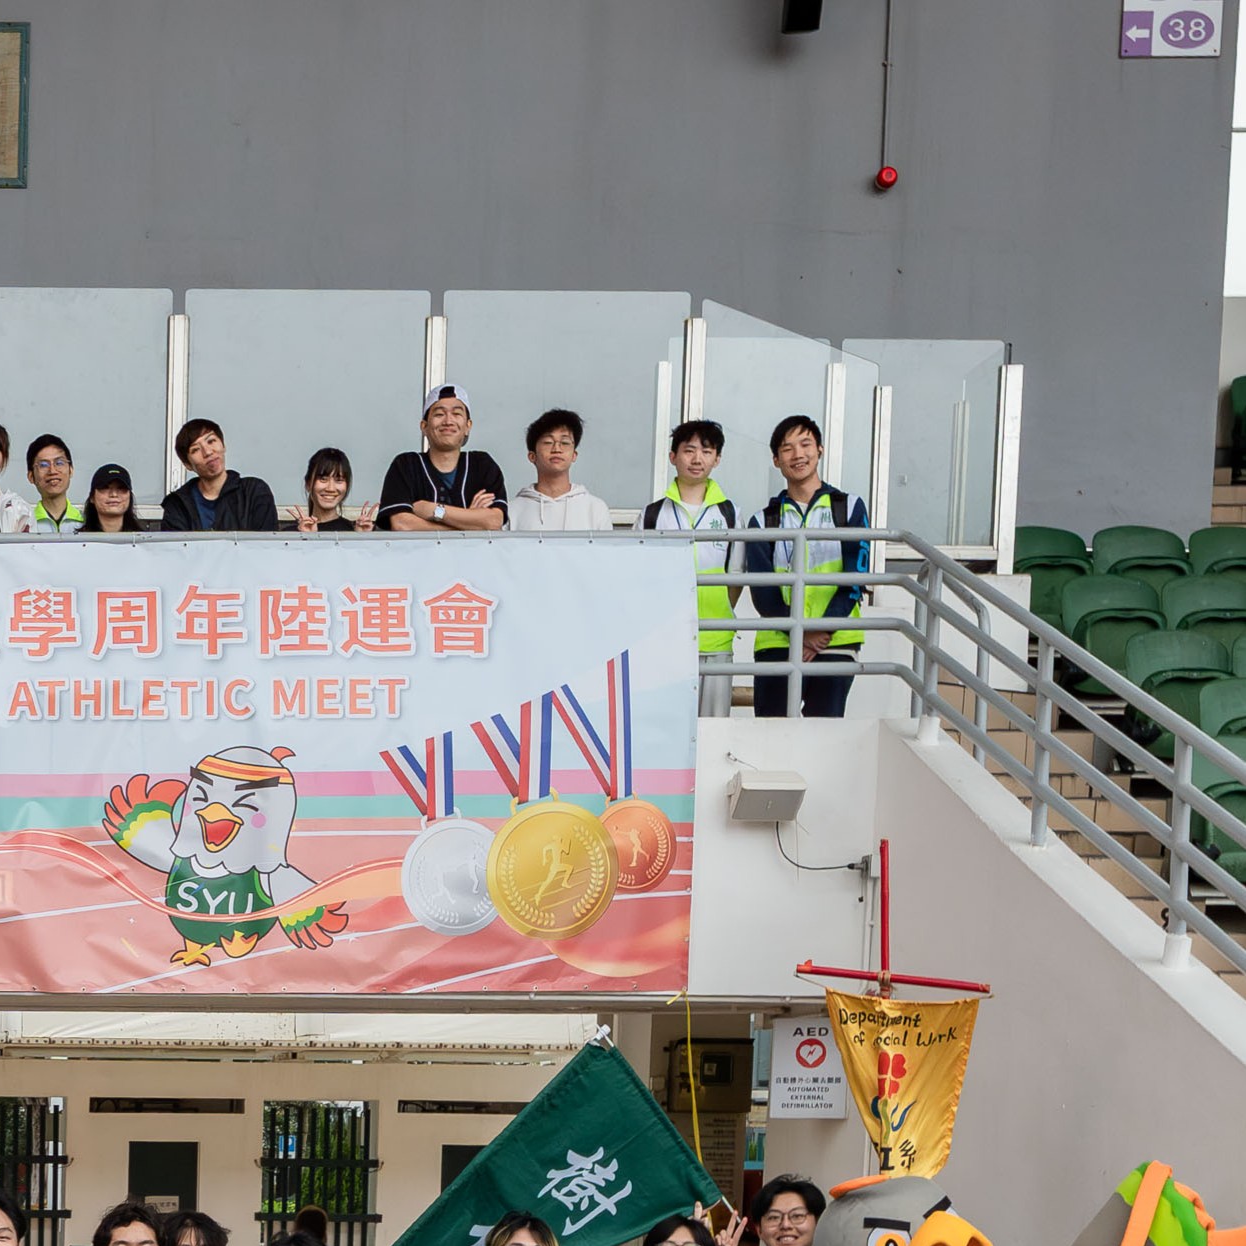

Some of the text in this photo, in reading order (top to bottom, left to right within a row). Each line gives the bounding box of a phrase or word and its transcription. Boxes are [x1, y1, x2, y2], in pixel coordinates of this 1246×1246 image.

[1167, 18, 1206, 42] 38
[8, 678, 254, 718] ATHLETIC
[272, 677, 407, 716] MEET
[176, 880, 254, 915] SYU
[792, 1027, 830, 1037] AED
[853, 1031, 865, 1047] of
[873, 1029, 908, 1047] ocial
